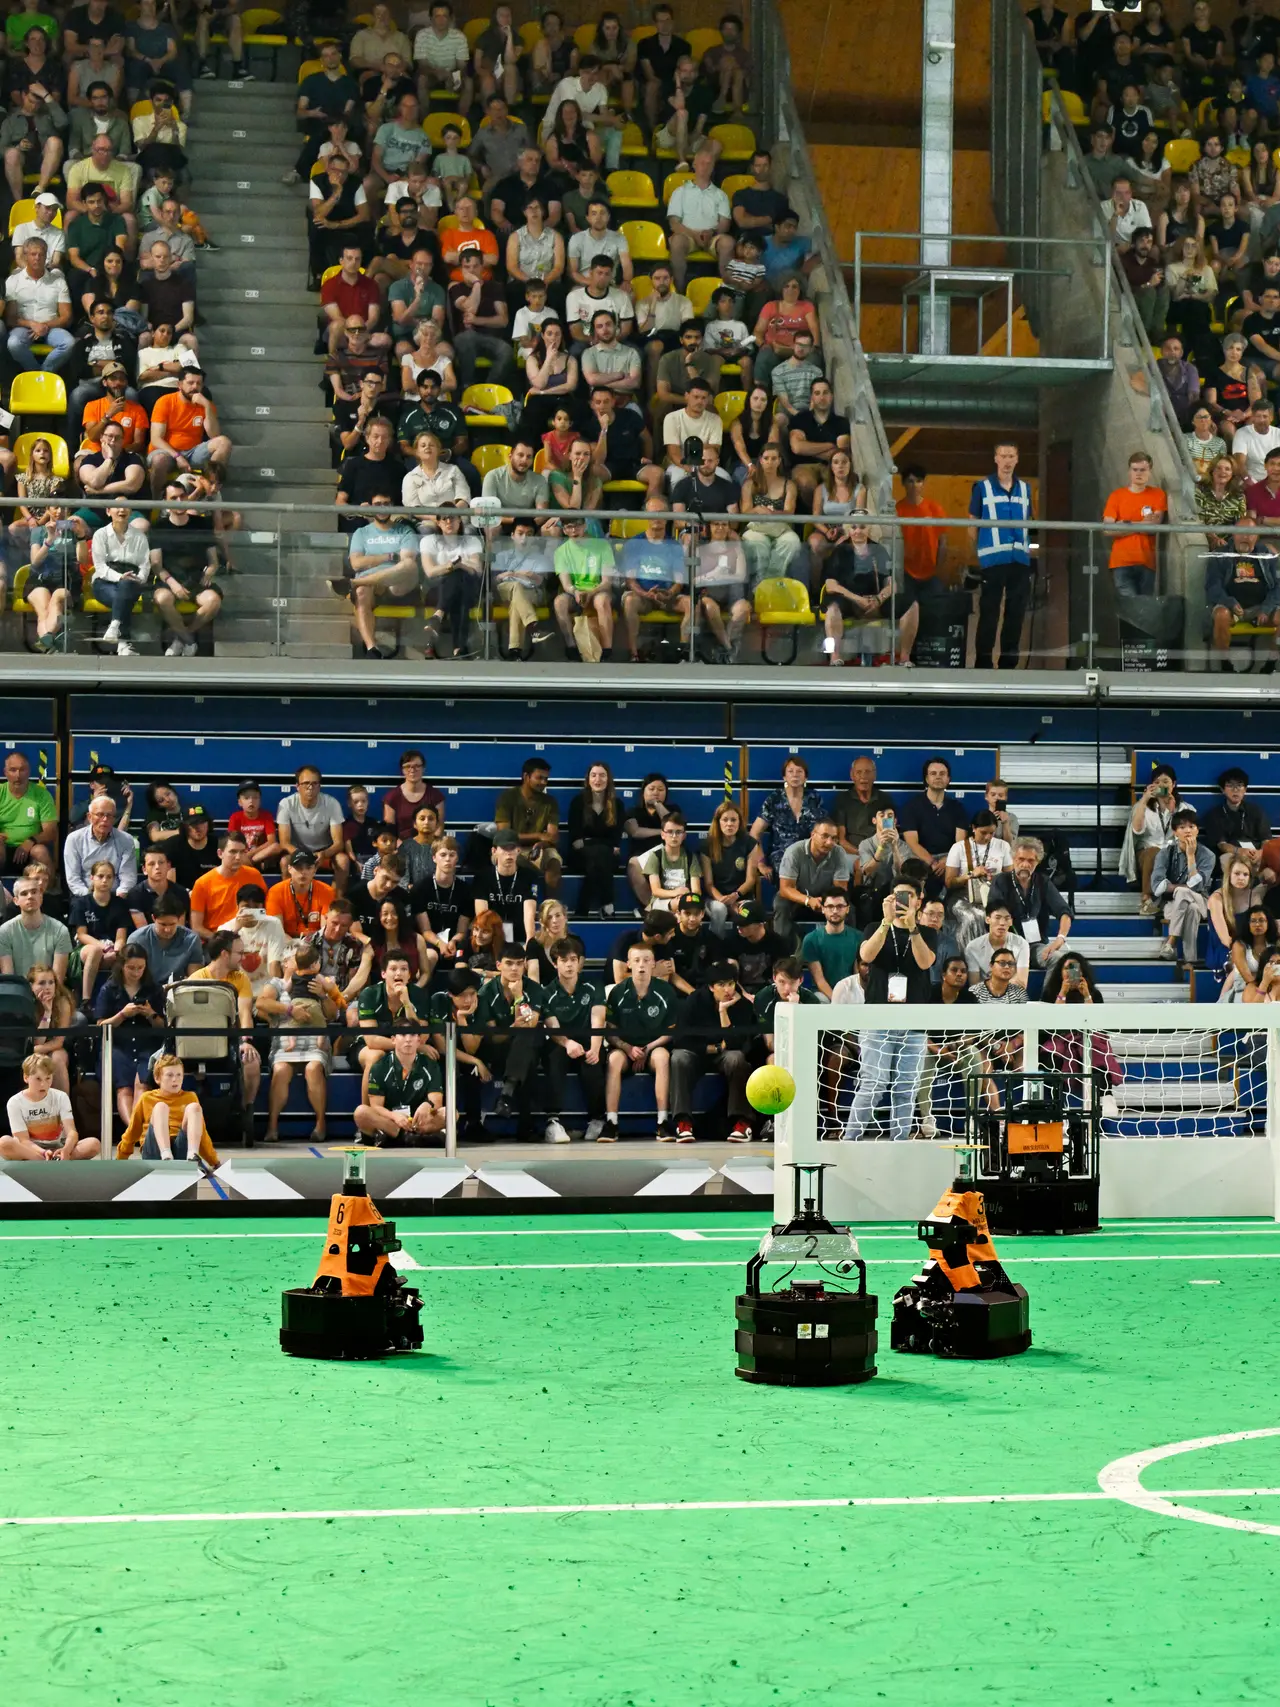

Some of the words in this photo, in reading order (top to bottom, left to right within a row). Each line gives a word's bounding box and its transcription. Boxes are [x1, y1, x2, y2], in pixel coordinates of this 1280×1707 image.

[29, 1108, 48, 1117] REAL
[1033, 1124, 1038, 1142] 1
[336, 1202, 345, 1224] 6
[368, 1202, 382, 1221] 6
[977, 1195, 984, 1215] 3
[1073, 1200, 1088, 1212] TU/e
[804, 1235, 819, 1259] 2
